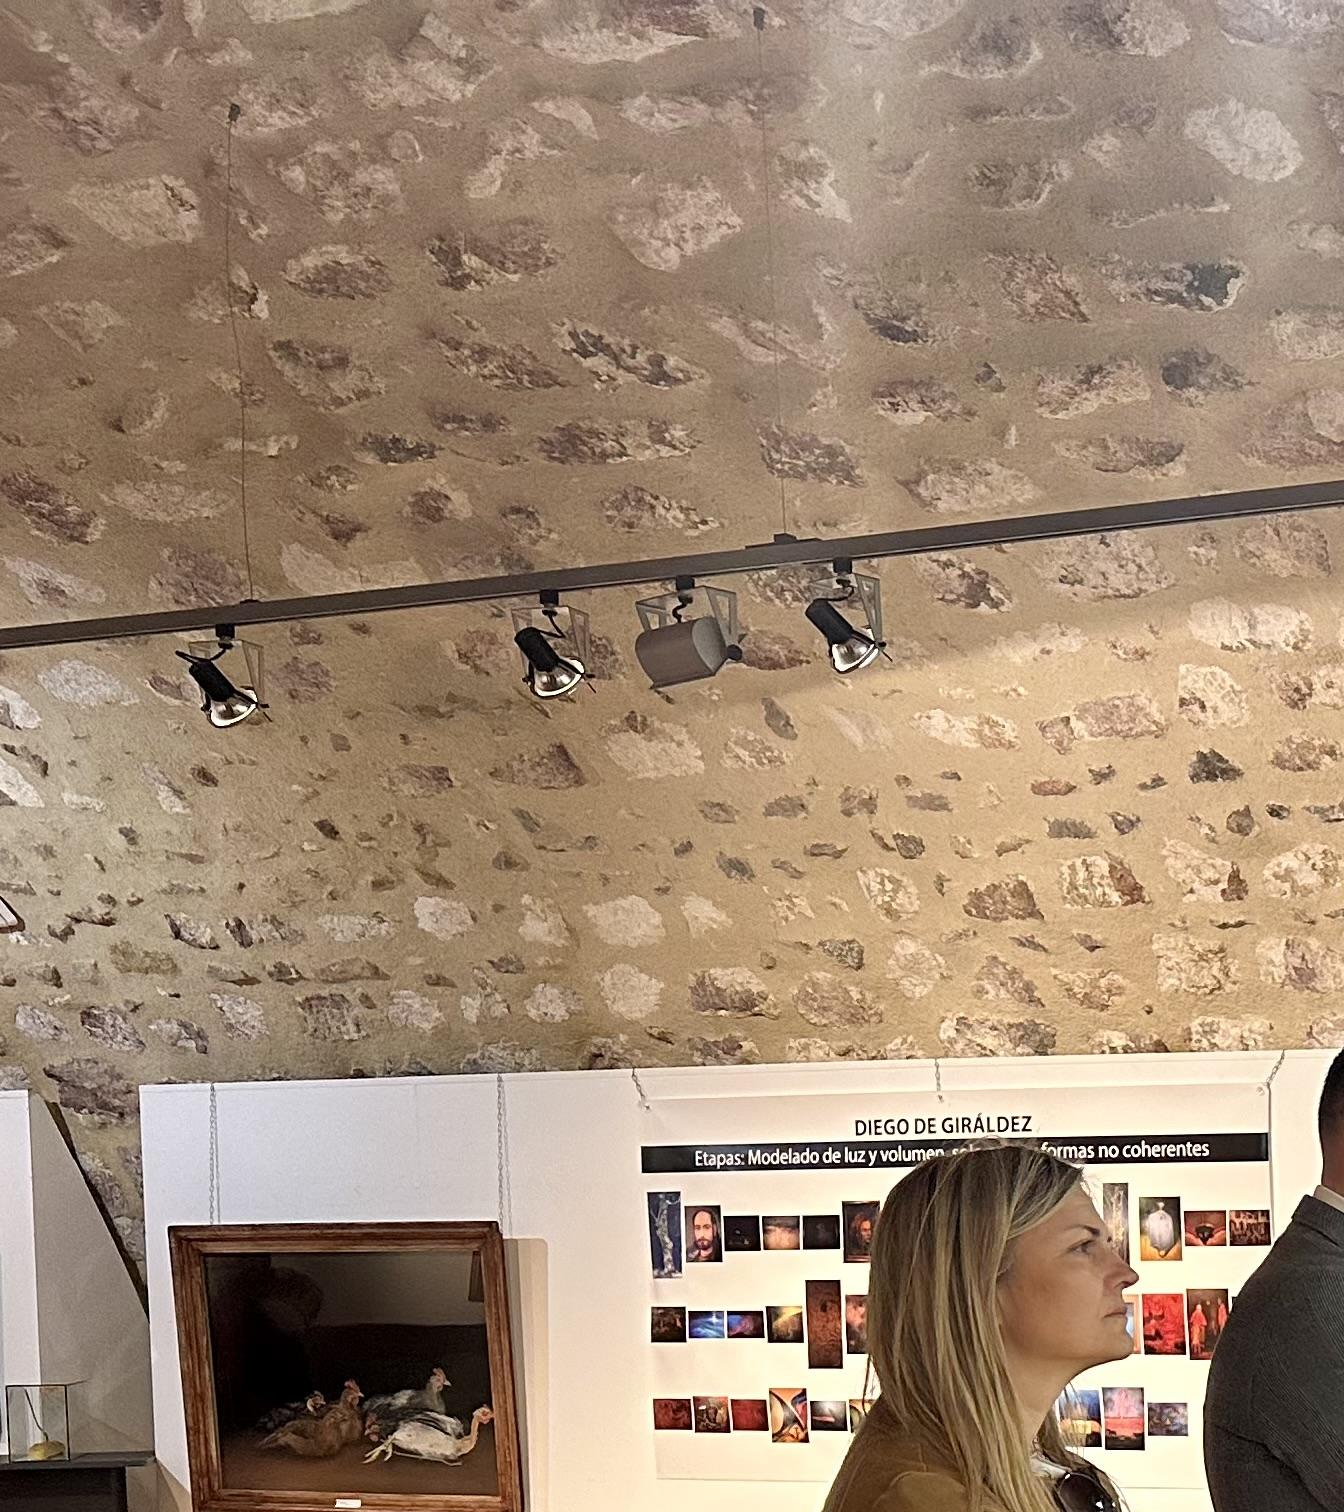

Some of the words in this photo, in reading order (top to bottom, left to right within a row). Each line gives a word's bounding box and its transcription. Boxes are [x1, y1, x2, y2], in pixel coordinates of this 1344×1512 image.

[855, 1118, 909, 1136] DIEGO
[914, 1117, 937, 1135] DE
[941, 1112, 1033, 1134] GIRÁLDEZ
[695, 1149, 745, 1169] Etapas:
[748, 1146, 819, 1166] Modelado
[822, 1145, 841, 1164] de
[844, 1146, 865, 1164] luz
[868, 1149, 880, 1167] y
[1098, 1143, 1119, 1159] no
[1122, 1139, 1210, 1159] coherentes
